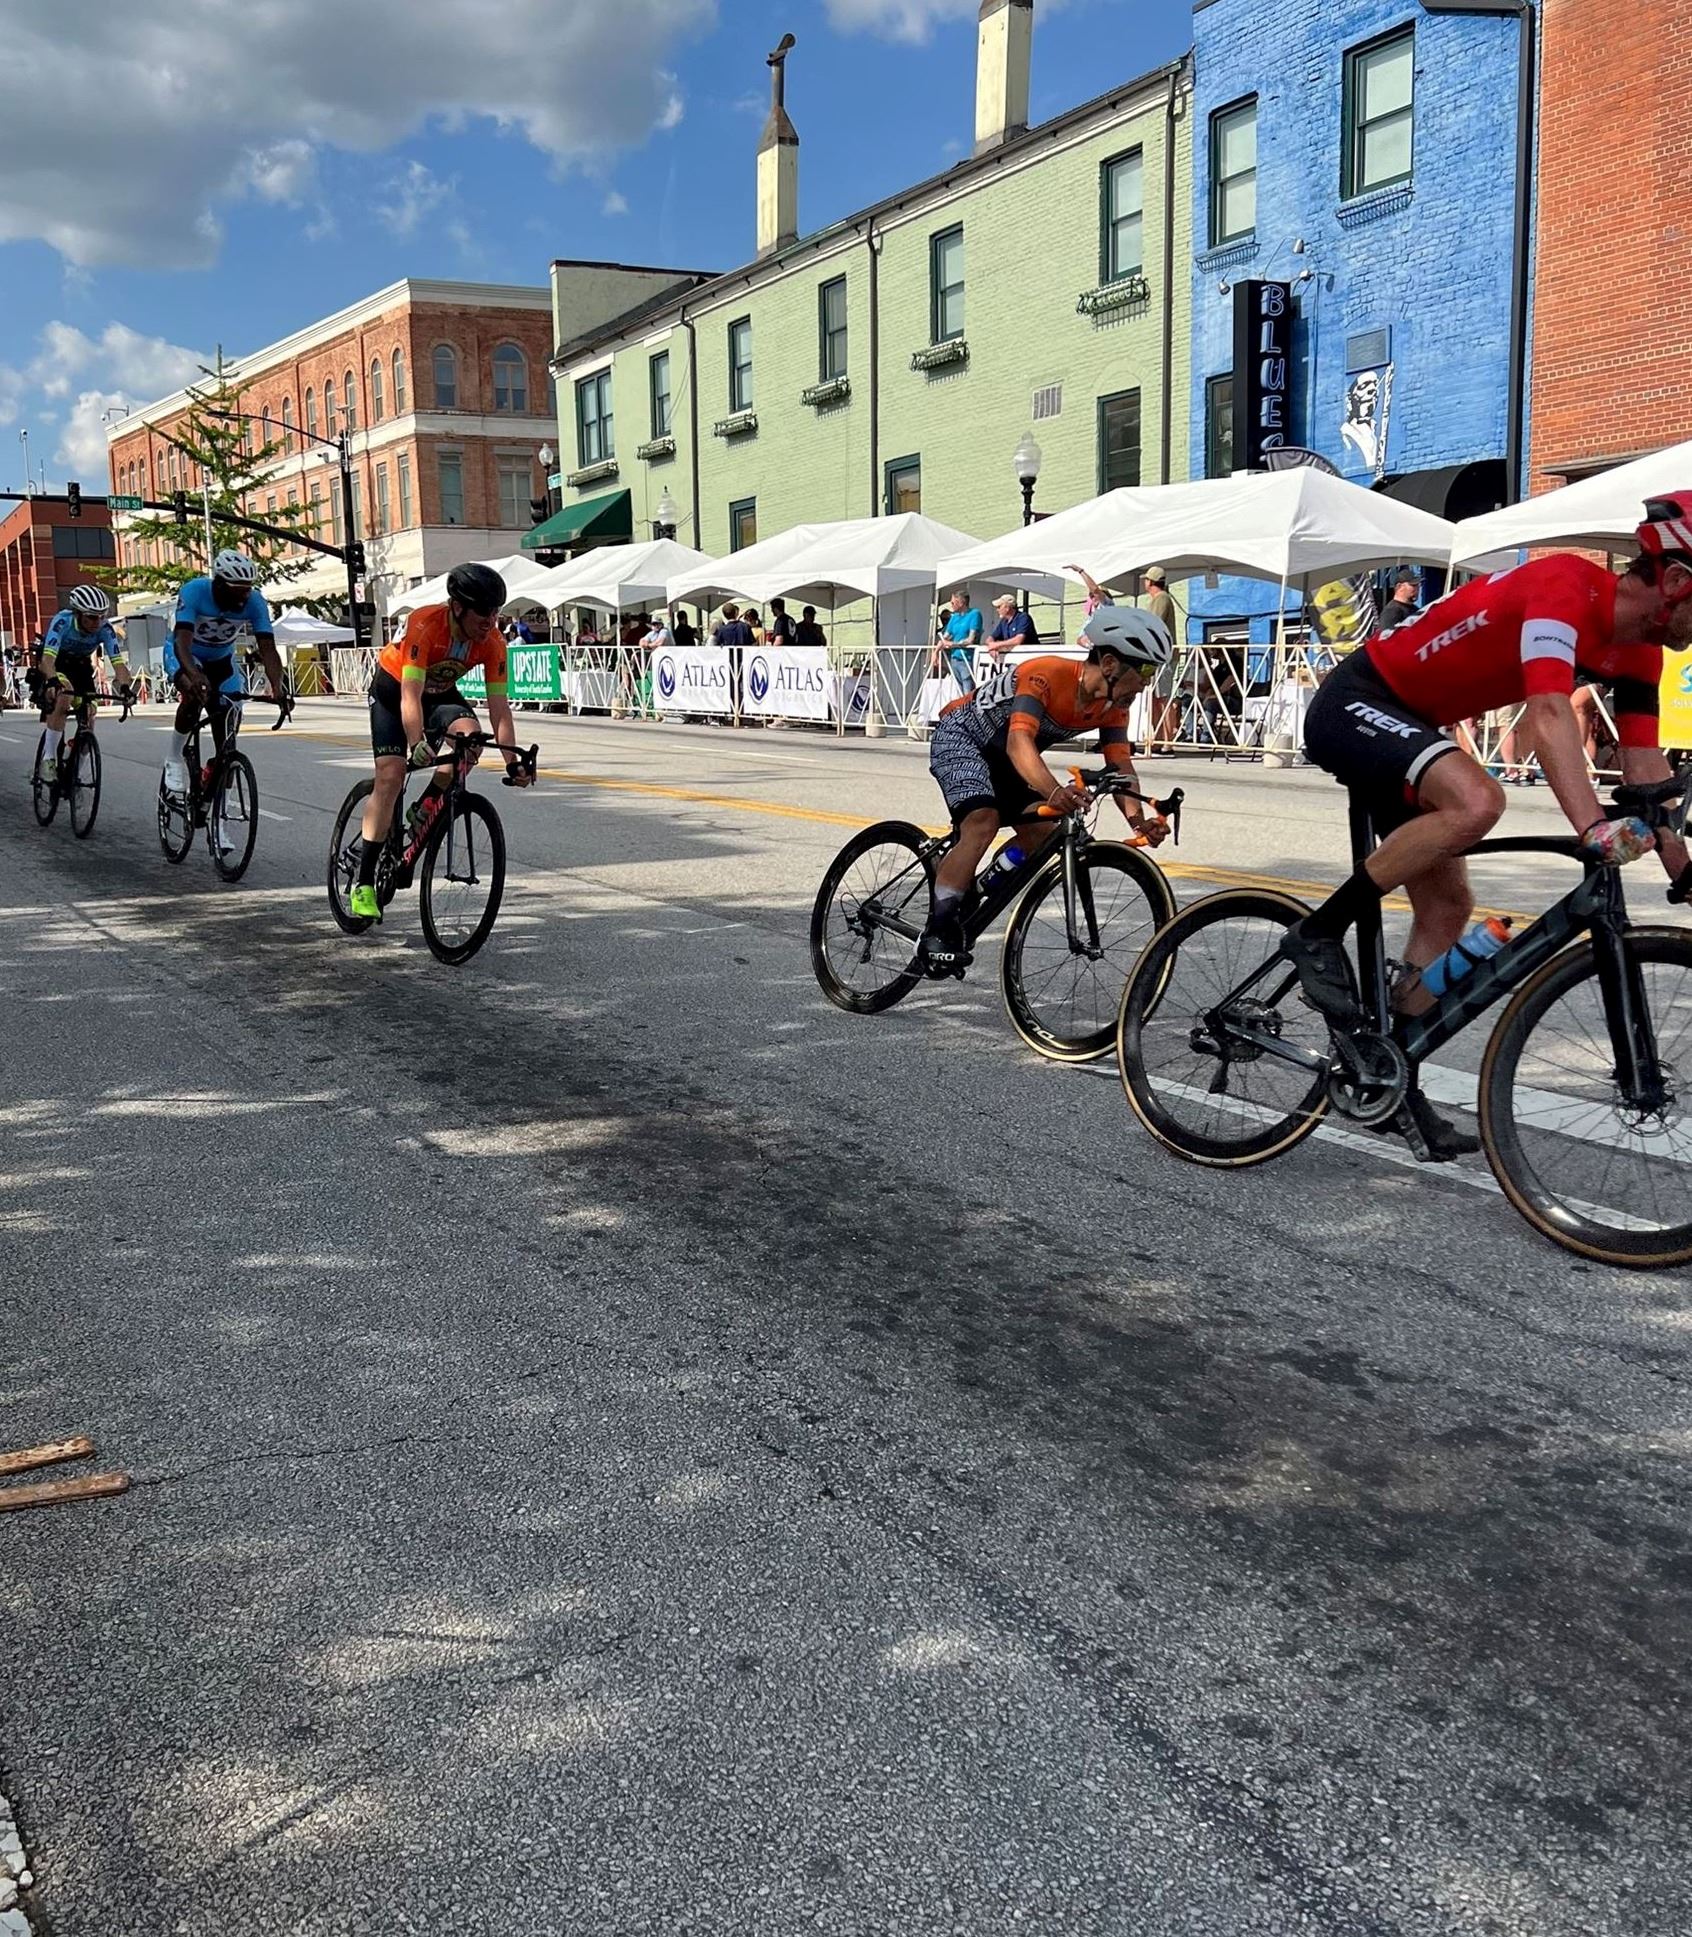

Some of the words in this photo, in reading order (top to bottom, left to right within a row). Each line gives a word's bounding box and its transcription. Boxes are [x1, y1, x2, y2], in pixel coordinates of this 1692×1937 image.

[110, 497, 130, 509] Main
[1414, 609, 1490, 662] TREK
[513, 650, 552, 682] UPSTATE
[681, 663, 726, 688] ATLAS
[775, 663, 824, 692] ATLAS
[1344, 701, 1422, 738] TREK
